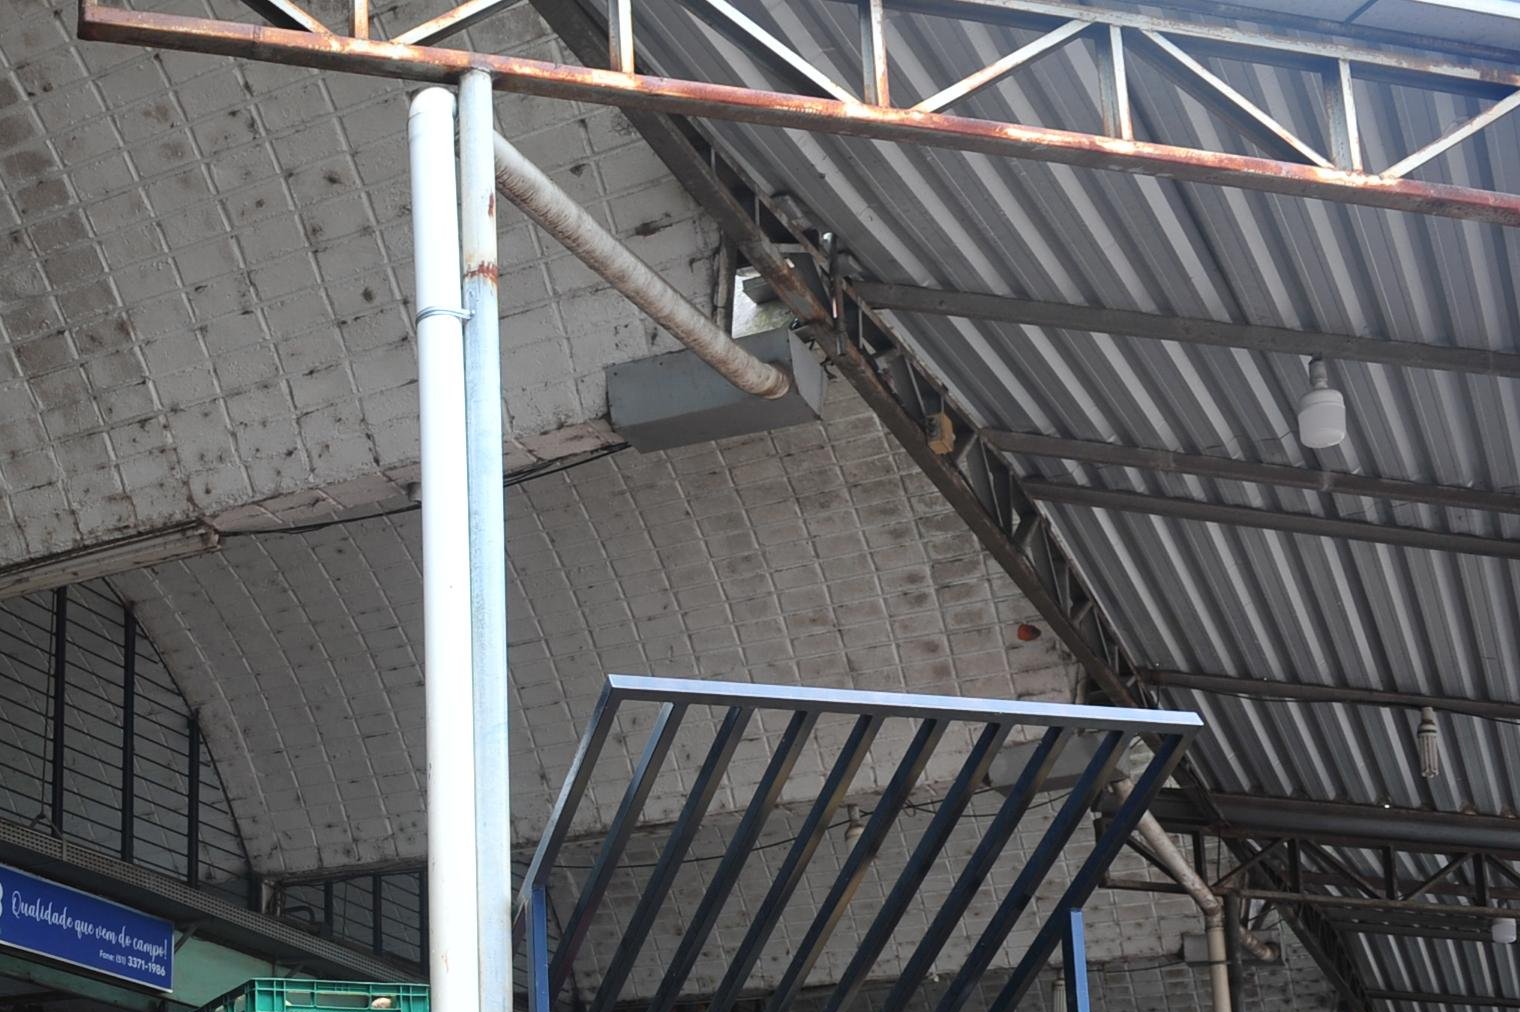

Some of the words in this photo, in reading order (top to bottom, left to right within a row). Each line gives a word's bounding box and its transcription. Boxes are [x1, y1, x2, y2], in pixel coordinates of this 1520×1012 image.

[11, 890, 73, 930] Qualidade
[74, 919, 94, 940] que
[95, 925, 117, 945] vem
[118, 925, 132, 948] do
[132, 937, 167, 963] campo!
[127, 955, 166, 977] 3371-1986
